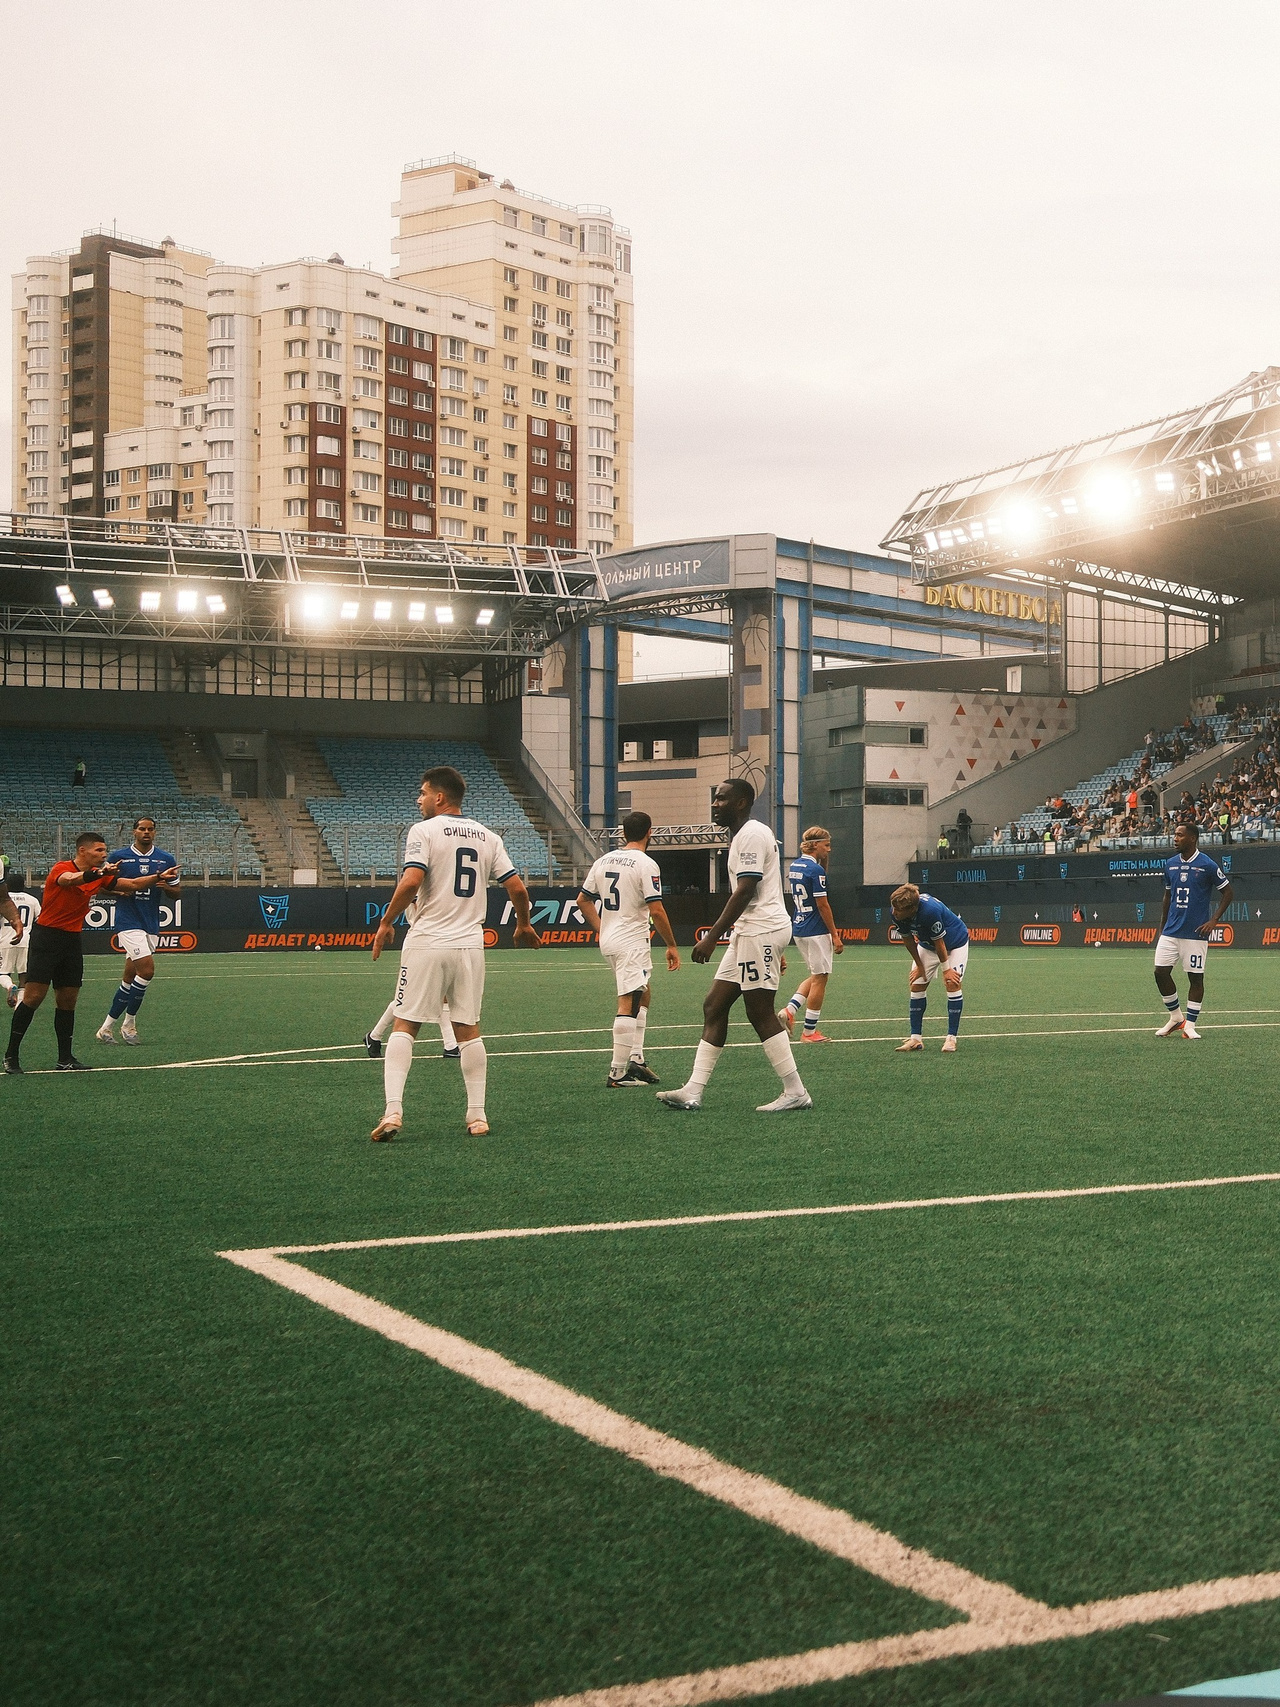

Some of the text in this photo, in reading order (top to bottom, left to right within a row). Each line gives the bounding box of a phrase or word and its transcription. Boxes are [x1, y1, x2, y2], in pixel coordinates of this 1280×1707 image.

[655, 560, 702, 579] ЦЕНТР
[443, 826, 486, 842] ФИЩЕНКО
[454, 847, 478, 898] 6
[1109, 859, 1137, 871] БИЛЕТЫ
[1139, 860, 1149, 869] НА
[603, 871, 620, 911] 3
[244, 933, 377, 949] ДЕЛАЕТ РАЗНИЦУ
[541, 930, 593, 945] ДЕЛАЕТ
[842, 928, 871, 942] РАЗНИЦУ
[1023, 929, 1053, 941] WINLINE
[1084, 928, 1157, 944] ДЕЛАЕТ РАЗНИЦУ
[763, 945, 773, 981] Vorgol
[1190, 954, 1202, 969] 91
[738, 960, 760, 983] 75
[396, 966, 408, 1007] Vorgol
